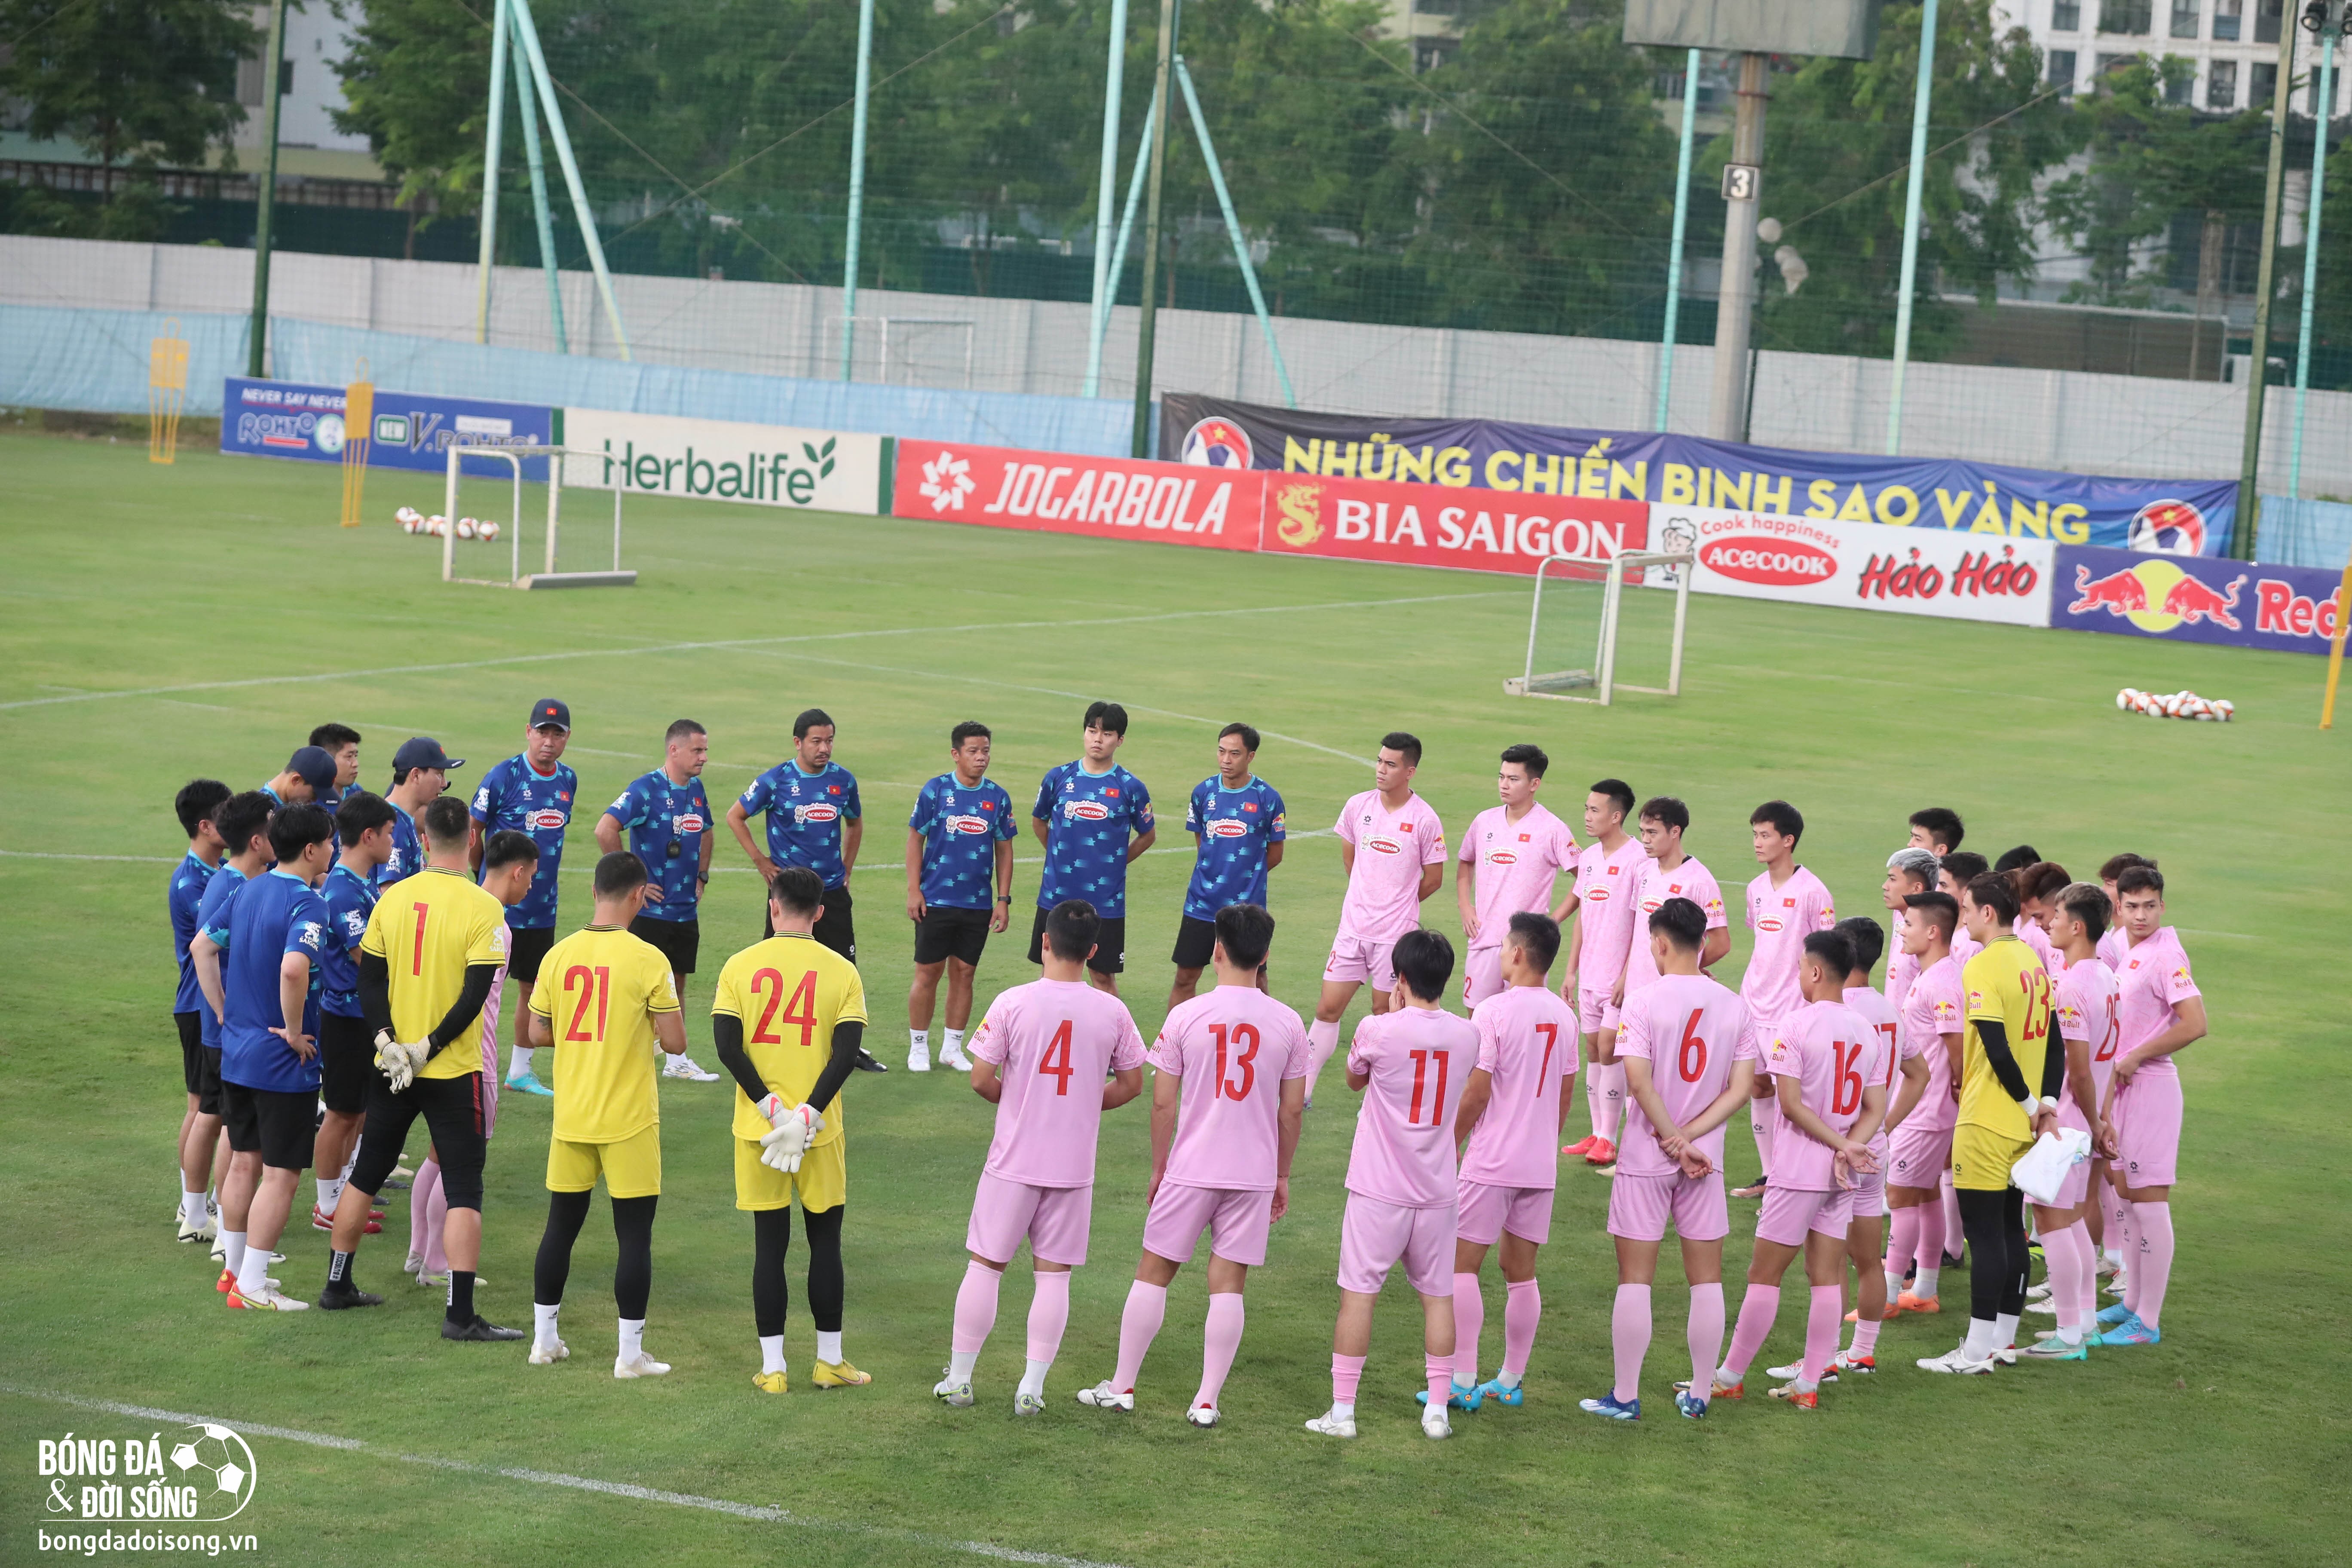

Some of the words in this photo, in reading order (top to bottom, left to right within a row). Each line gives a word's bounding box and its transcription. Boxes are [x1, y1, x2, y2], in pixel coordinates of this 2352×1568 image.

[1730, 168, 1751, 198] 3
[237, 412, 317, 446] ROHTO
[241, 387, 283, 404] NEVER
[283, 392, 308, 406] SAY
[604, 439, 815, 504] Herbalife
[984, 462, 1232, 535] JOGARBOLA
[1283, 432, 1472, 487] NHỮNG
[1485, 438, 1648, 502] CHIẾN
[1661, 462, 1792, 515] BINH
[1803, 479, 1920, 526] SAO
[1935, 480, 2090, 545] VÀNG
[1335, 499, 1427, 547] BIA
[1437, 507, 1625, 559] SAIGON
[1701, 514, 1745, 535] Cook
[1752, 514, 1840, 549] happiness
[1857, 546, 1944, 600] Hảo
[1952, 545, 2038, 597] Hảo
[413, 902, 429, 977] 1
[564, 965, 609, 1042] 21
[751, 968, 818, 1046] 24
[2019, 966, 2052, 1041] 23
[2175, 980, 2187, 989] Red
[974, 1031, 986, 1044] Bull
[1039, 1020, 1074, 1096] 4
[1152, 1044, 1162, 1054] ull
[1208, 1023, 1261, 1101] 13
[1536, 1023, 1558, 1098] 7
[1678, 1008, 1707, 1082] 6
[1772, 1053, 1785, 1062] Bull
[1873, 1023, 1896, 1092] 7
[1409, 1049, 1449, 1126] 11
[1831, 1041, 1862, 1115] 16
